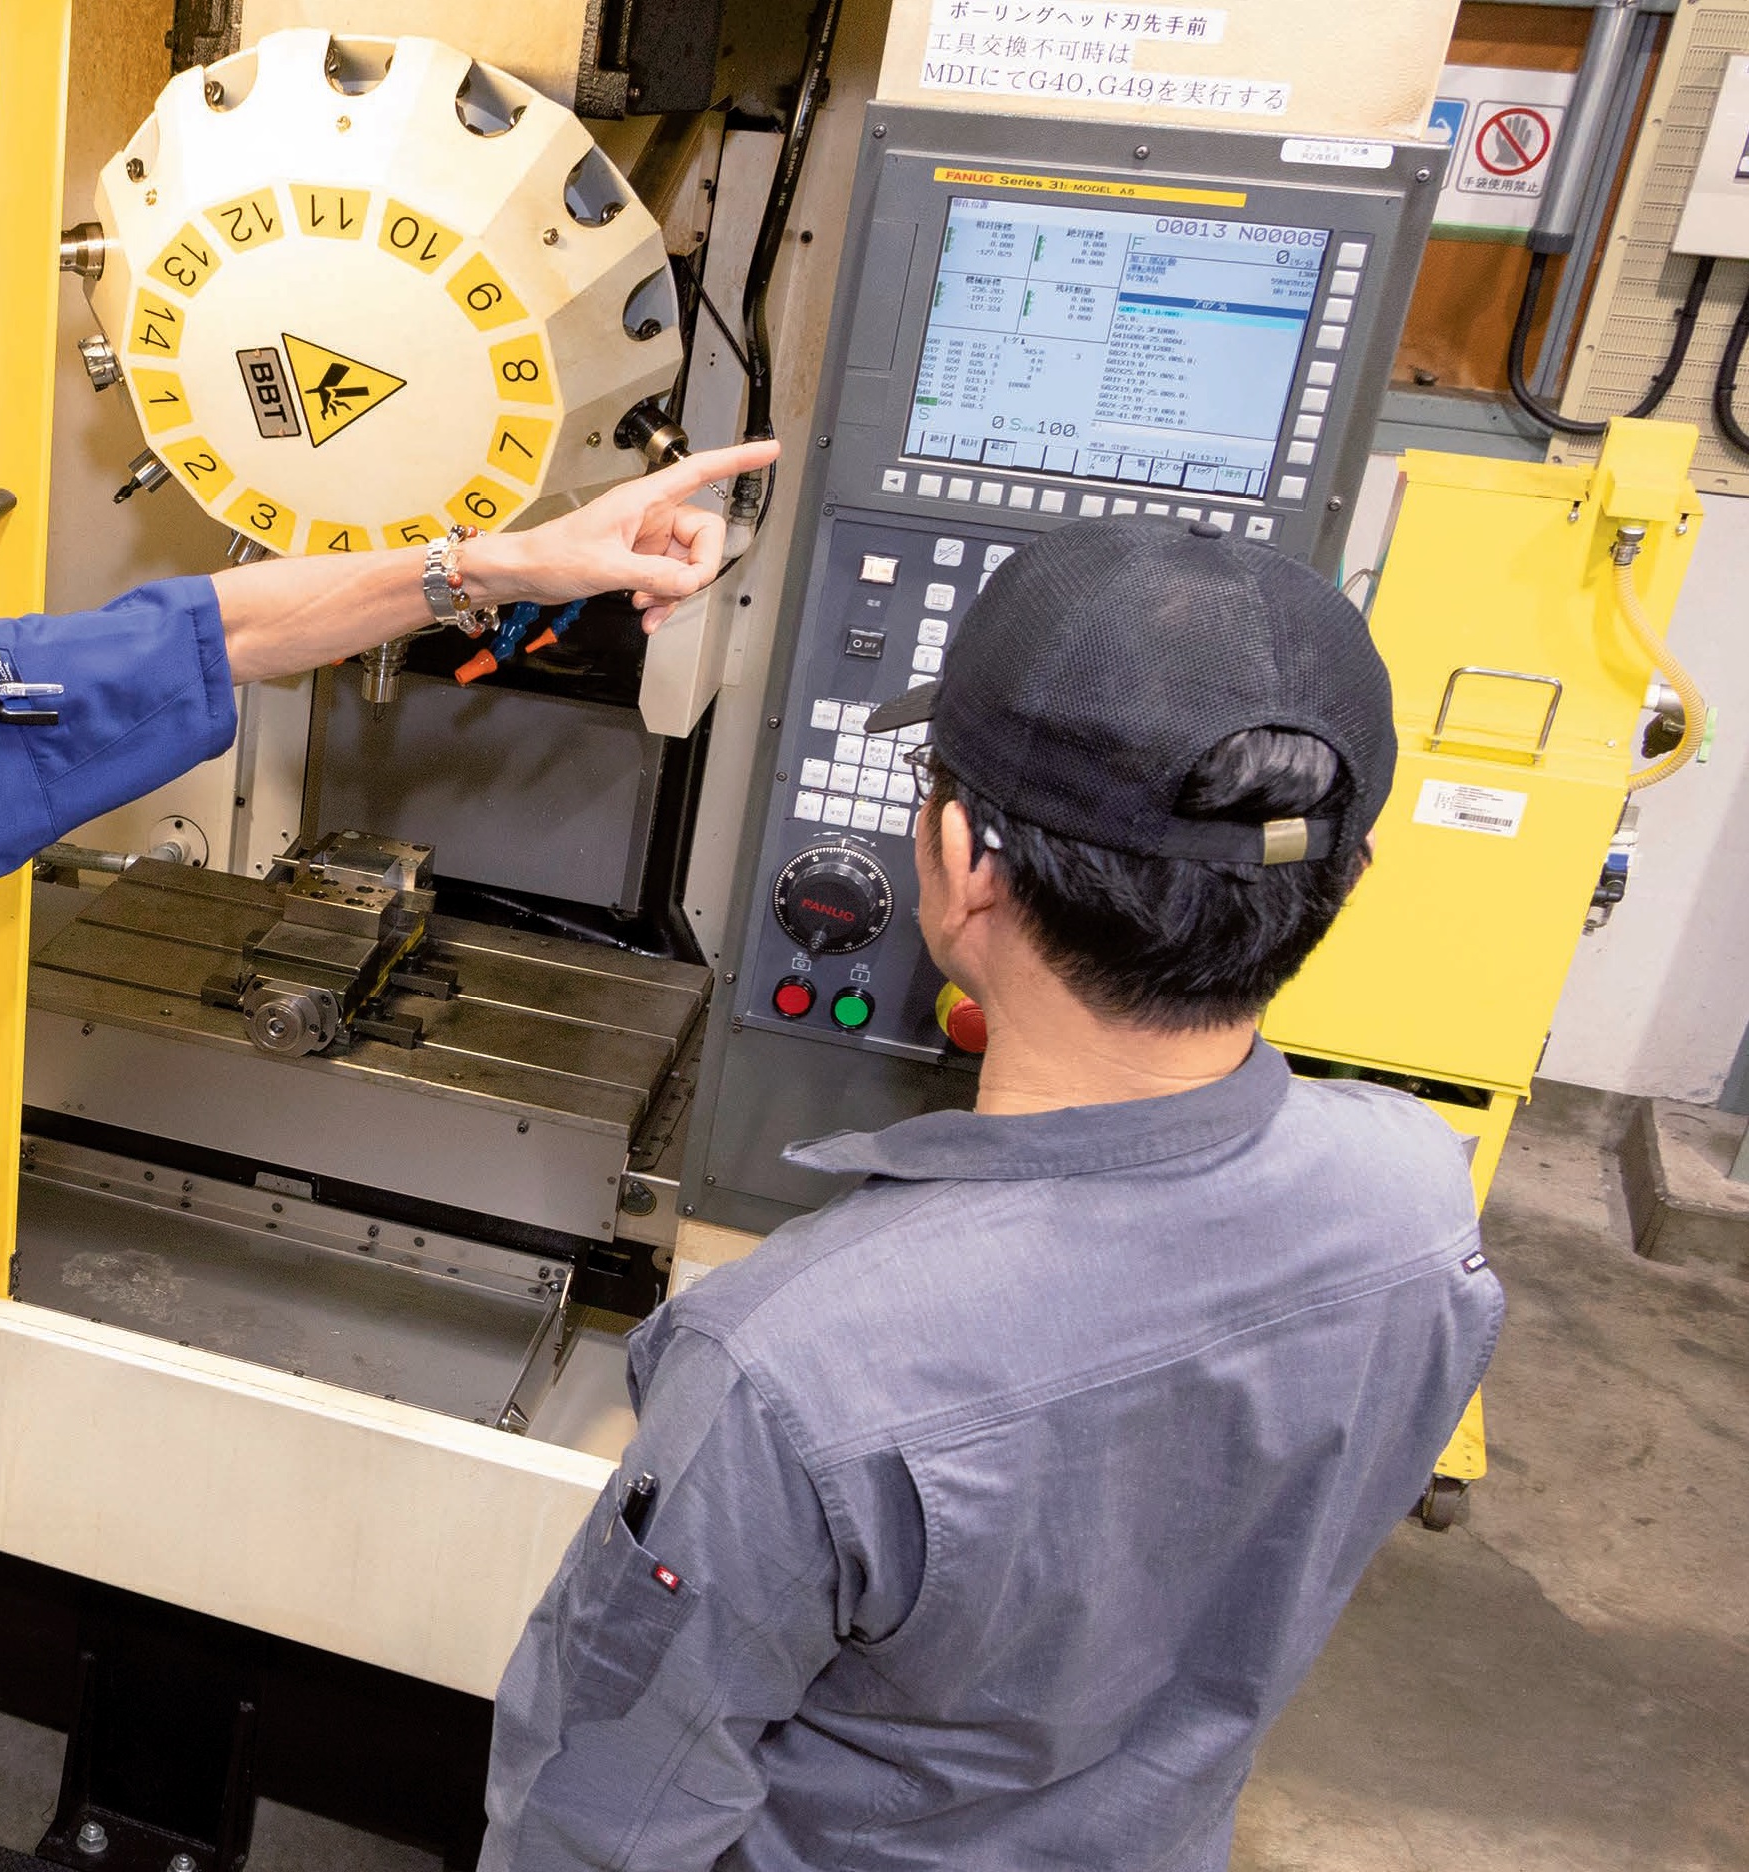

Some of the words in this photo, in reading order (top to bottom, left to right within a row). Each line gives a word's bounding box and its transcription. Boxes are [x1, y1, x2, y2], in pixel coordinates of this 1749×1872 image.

[930, 32, 1132, 66] 工具交換不可時は
[945, 171, 993, 184] FANUC
[999, 176, 1042, 189] Series
[1464, 176, 1539, 193] 手袋使用禁止
[221, 202, 273, 241] 12
[311, 194, 353, 230] 11
[390, 216, 438, 261] 10
[1239, 226, 1327, 247] N00005
[164, 243, 209, 286] 13
[1276, 250, 1290, 264] 0
[139, 308, 175, 349] 14
[502, 359, 539, 382] 8
[149, 390, 179, 403] 1
[249, 362, 288, 424] BBT
[918, 407, 930, 420] S
[992, 416, 1004, 428] 0
[499, 431, 533, 459] 7
[184, 453, 217, 481] 2
[250, 503, 278, 531] 3
[328, 530, 350, 552] 4
[864, 641, 878, 649] OFF
[801, 899, 855, 922] FANUC
